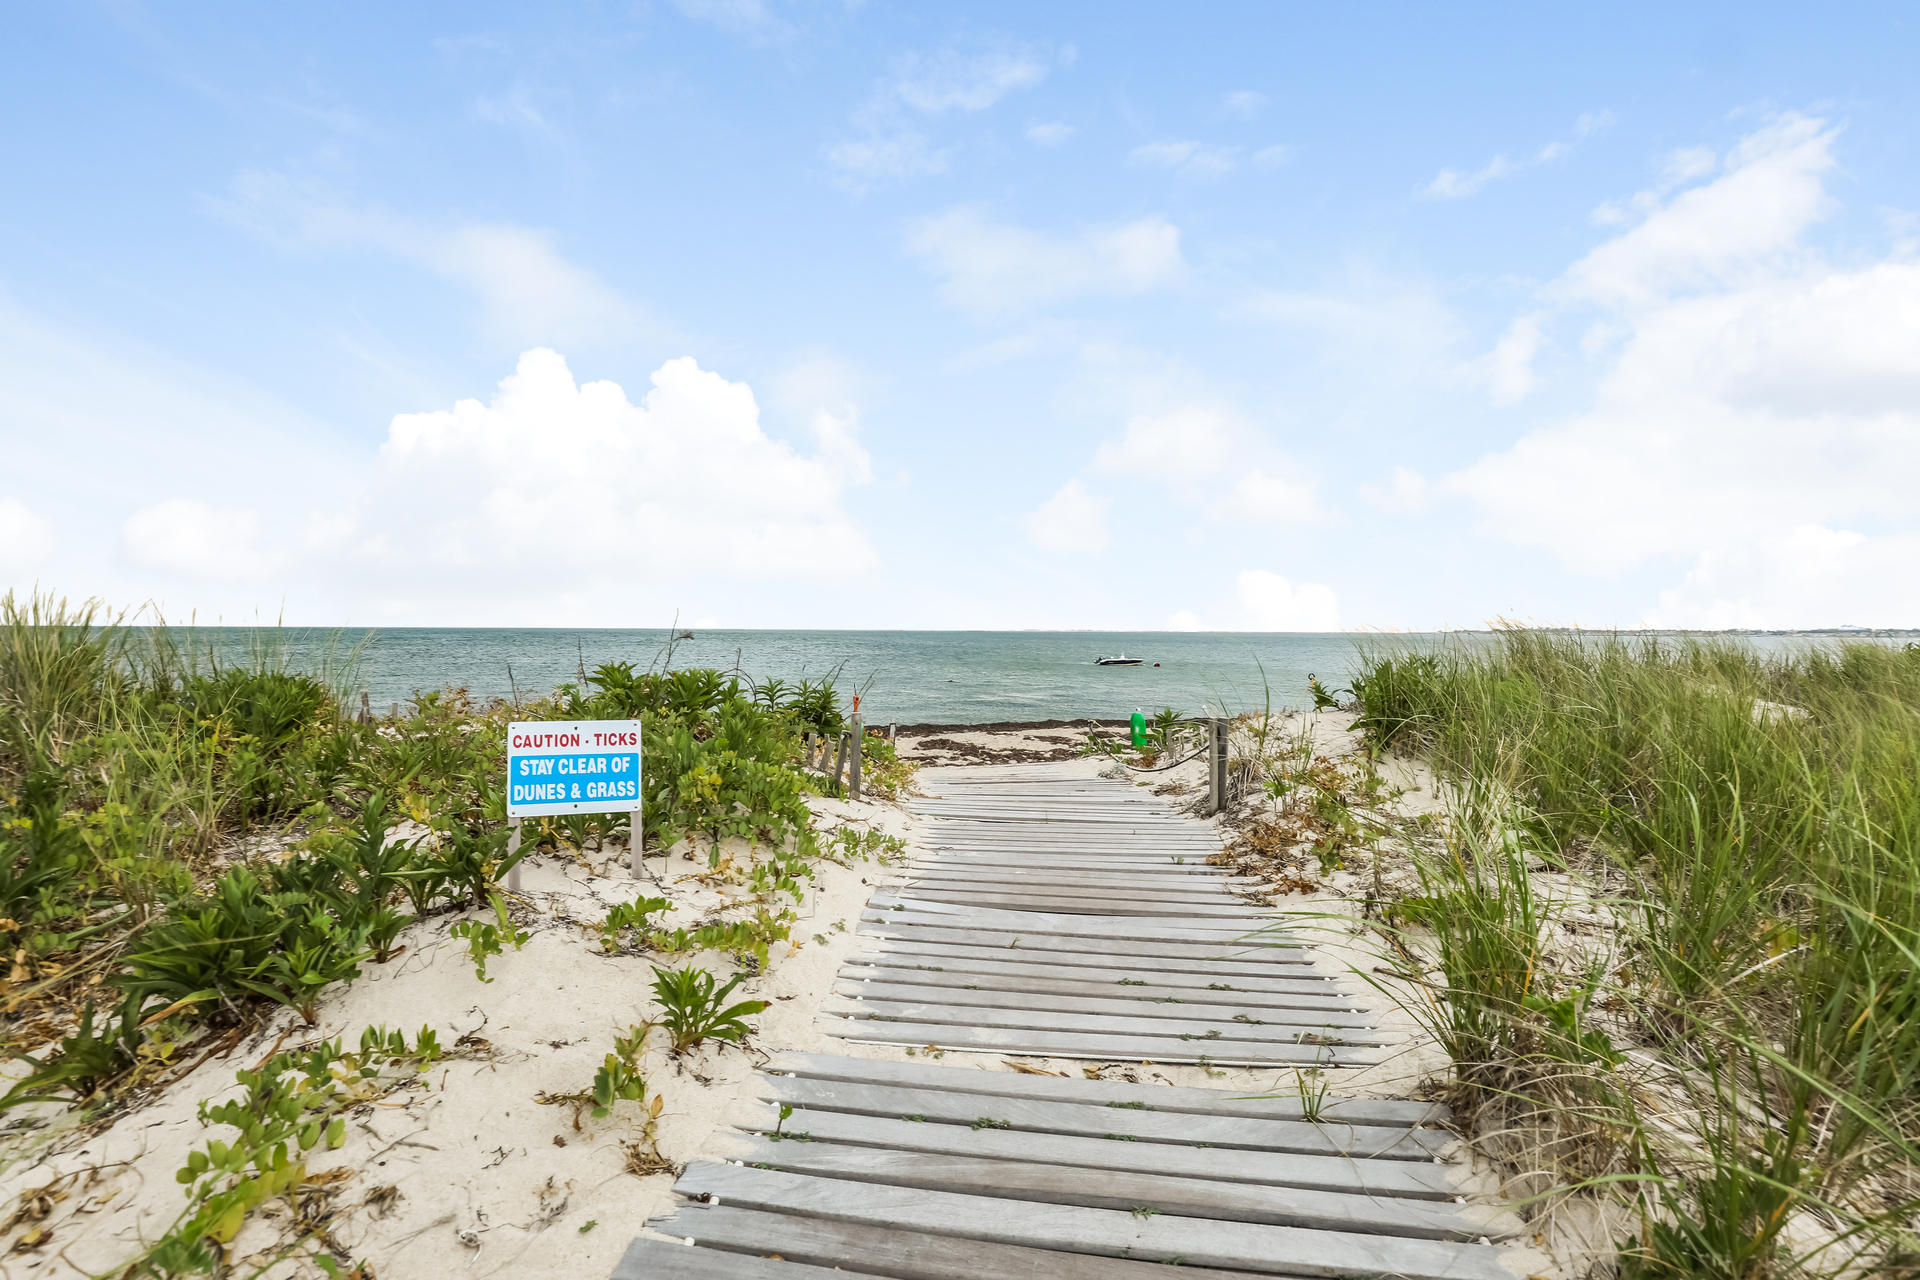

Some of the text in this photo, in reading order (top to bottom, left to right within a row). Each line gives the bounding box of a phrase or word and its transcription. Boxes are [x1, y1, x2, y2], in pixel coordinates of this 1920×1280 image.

[513, 734, 580, 748] CAUTION
[594, 733, 637, 747] TICKS
[520, 757, 630, 776] STAY CLEAR OF
[514, 781, 635, 801] DUNES & GRASS
